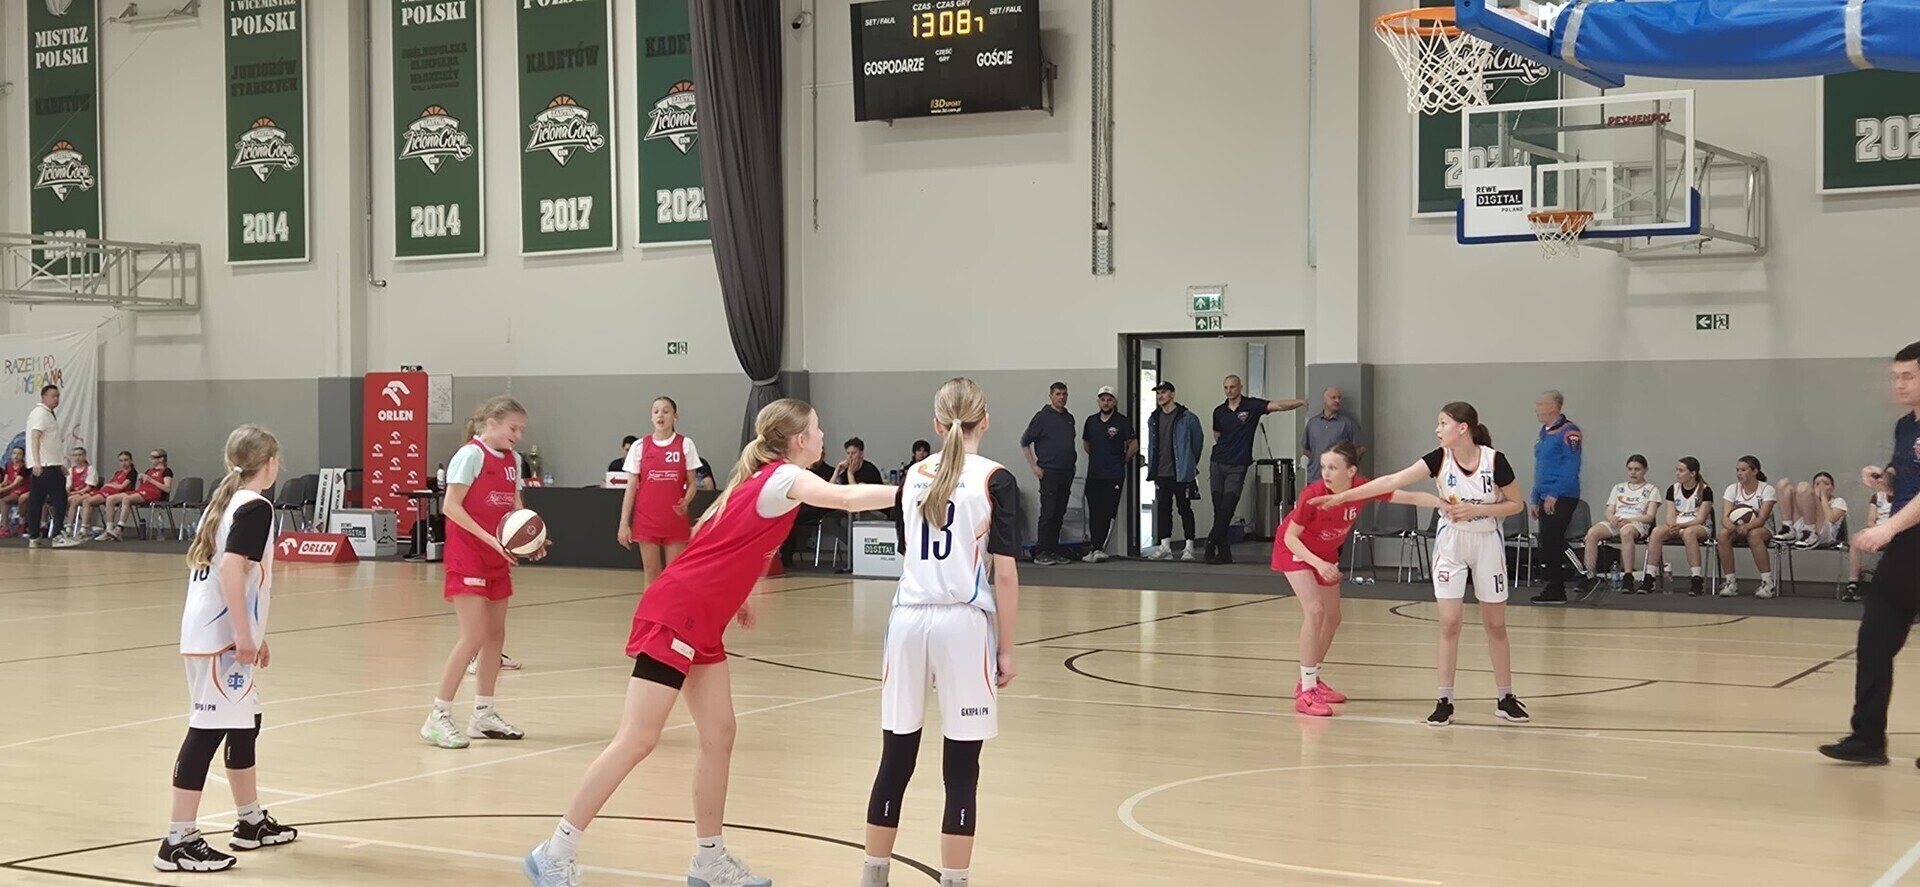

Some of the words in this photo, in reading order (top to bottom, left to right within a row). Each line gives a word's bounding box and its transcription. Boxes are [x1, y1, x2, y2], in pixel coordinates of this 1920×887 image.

[401, 1, 467, 26] POLSKI
[912, 3, 931, 11] CZAS
[936, 1, 955, 9] CZAS
[231, 11, 296, 36] POLSKI
[35, 26, 88, 48] MISTRZ
[36, 47, 88, 69] POLSKI
[527, 41, 599, 74] KADETÓW
[864, 57, 925, 76] GOSPODARZE
[977, 48, 1013, 67] GOŚCIE
[410, 203, 461, 238] 2014
[540, 196, 593, 233] 2017
[242, 210, 289, 244] 2014
[5, 356, 40, 374] RAZEM
[43, 354, 55, 370] PO
[377, 410, 413, 421] ORLEN
[665, 451, 680, 463] 20
[504, 466, 516, 481] 10
[1343, 507, 1357, 521] 16
[917, 500, 955, 560] 13
[301, 543, 334, 553] ORLEN
[1493, 573, 1504, 593] 19
